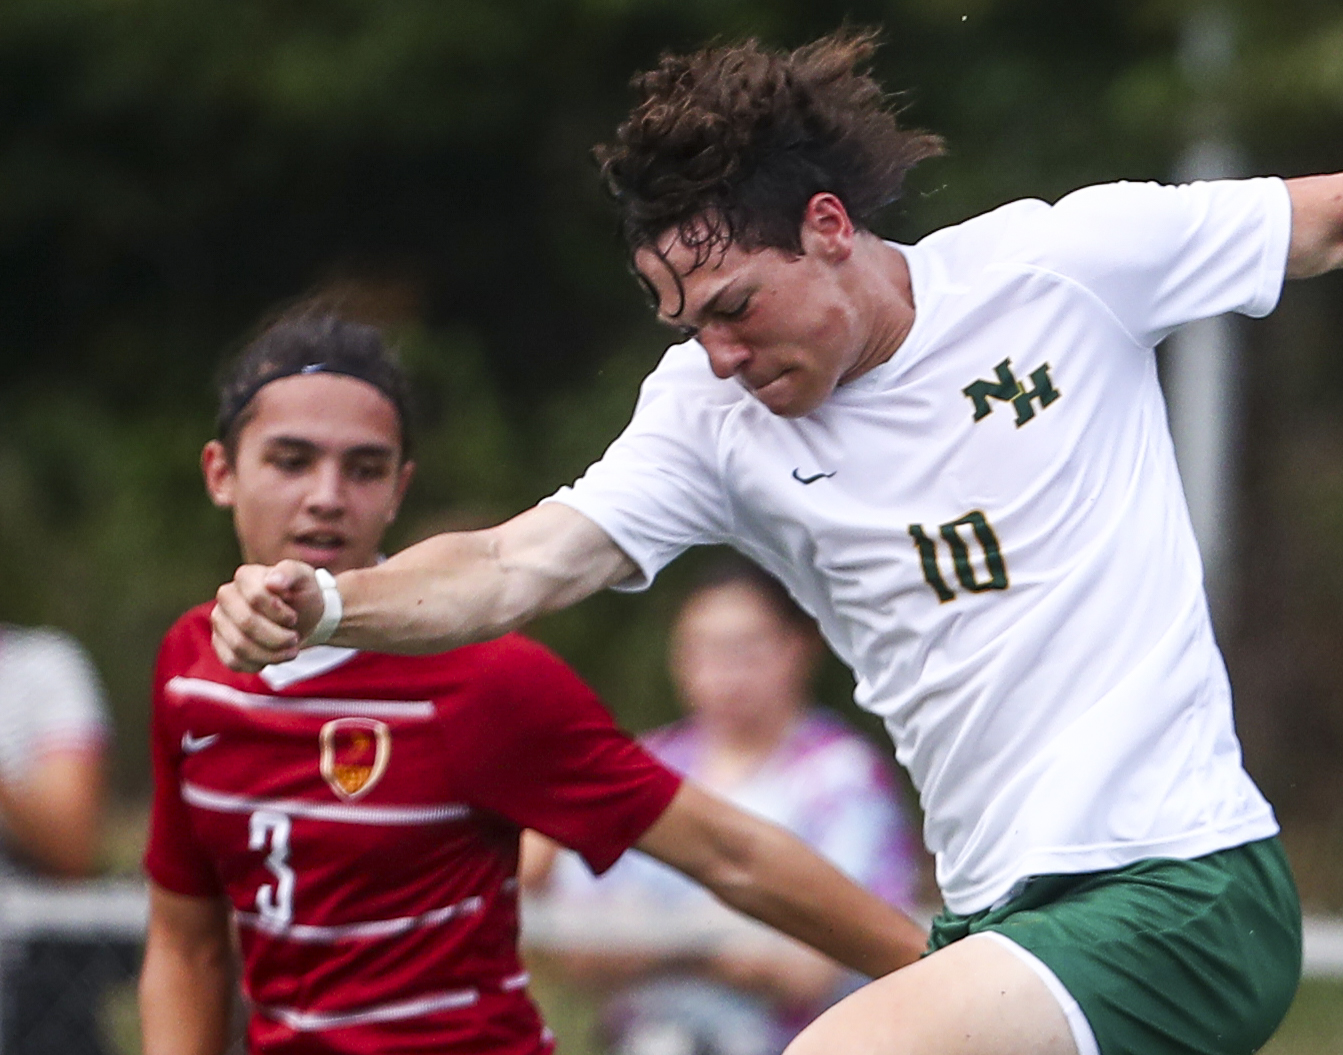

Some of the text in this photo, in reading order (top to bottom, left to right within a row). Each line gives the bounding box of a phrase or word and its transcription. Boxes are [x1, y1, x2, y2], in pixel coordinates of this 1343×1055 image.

[963, 357, 1061, 428] NH
[908, 510, 1009, 604] 10
[249, 811, 294, 934] 3
